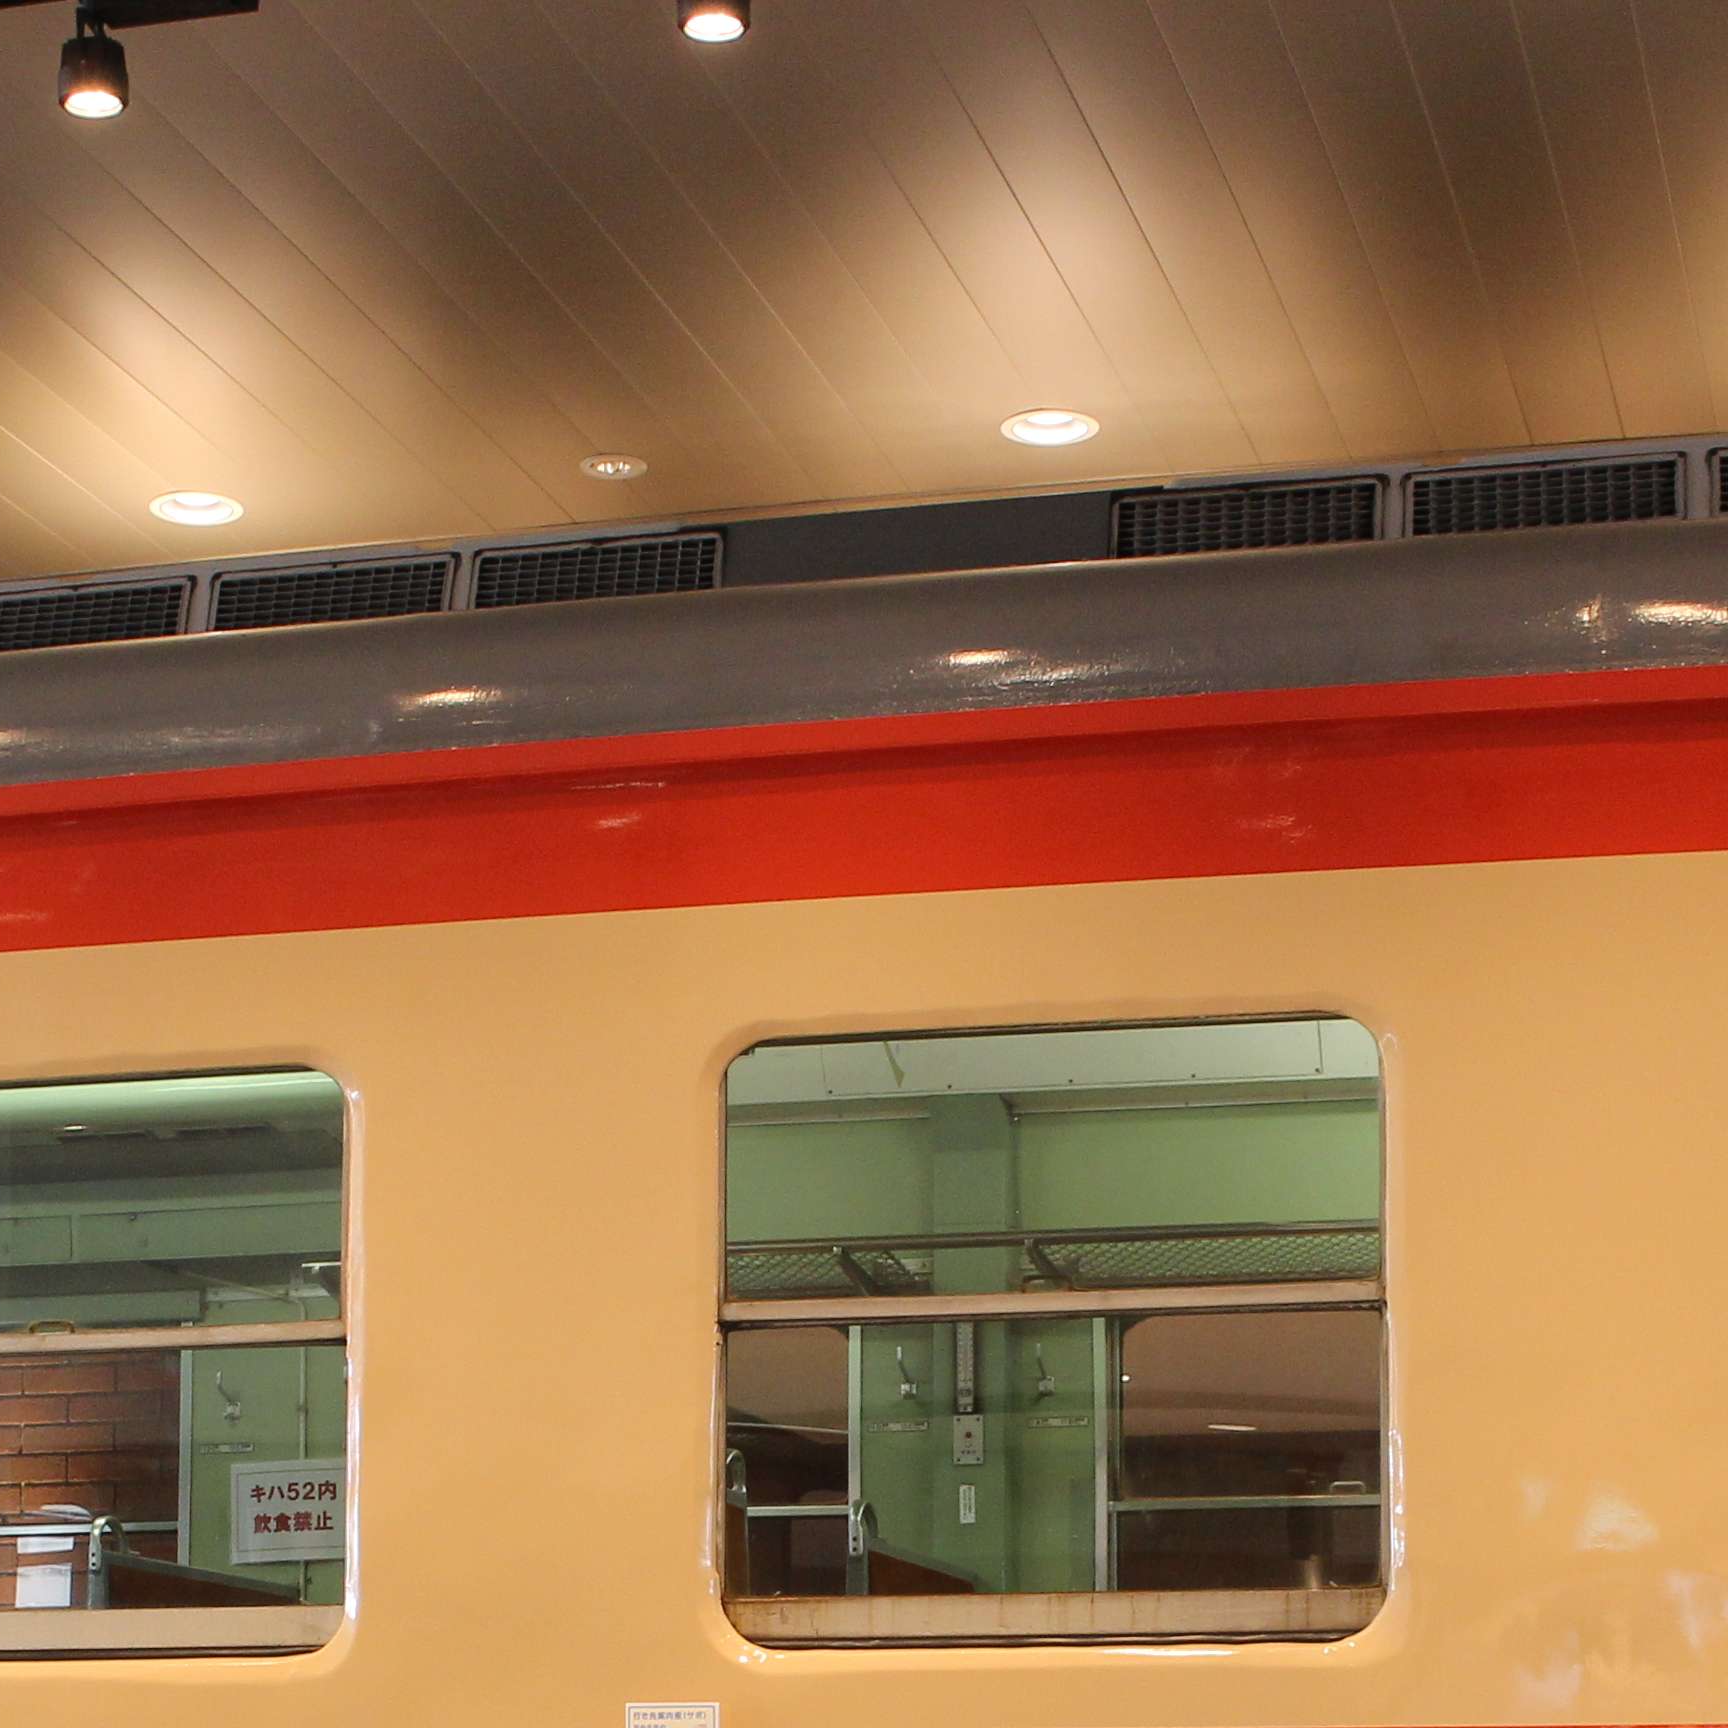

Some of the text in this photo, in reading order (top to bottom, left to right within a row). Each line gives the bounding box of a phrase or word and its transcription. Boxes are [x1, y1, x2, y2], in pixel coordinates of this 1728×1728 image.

[250, 1480, 338, 1504] キハ52内
[253, 1510, 335, 1534] 飲食禁止
